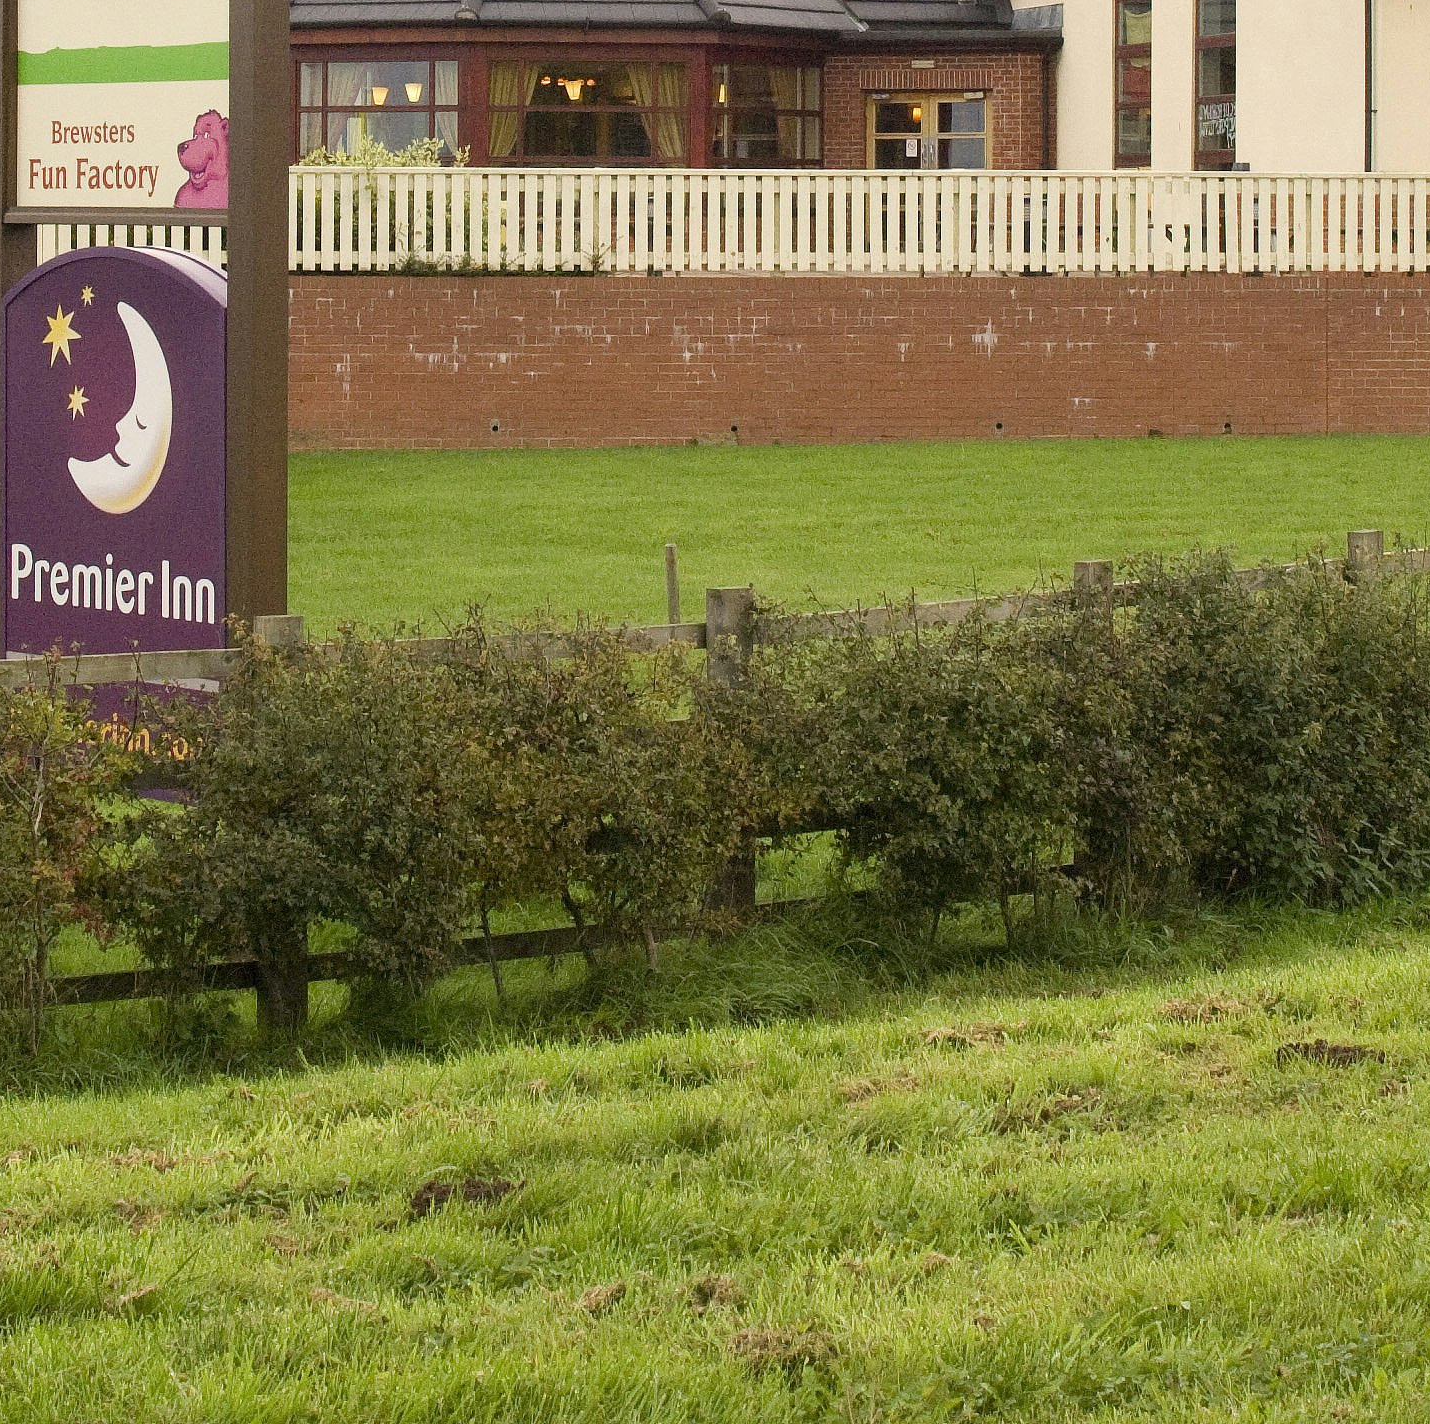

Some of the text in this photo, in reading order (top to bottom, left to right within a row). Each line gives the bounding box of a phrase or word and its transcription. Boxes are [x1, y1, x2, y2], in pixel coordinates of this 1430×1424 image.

[51, 120, 135, 144] Brewsters
[28, 157, 160, 198] Fun Factory
[11, 543, 215, 625] Premier Inn
